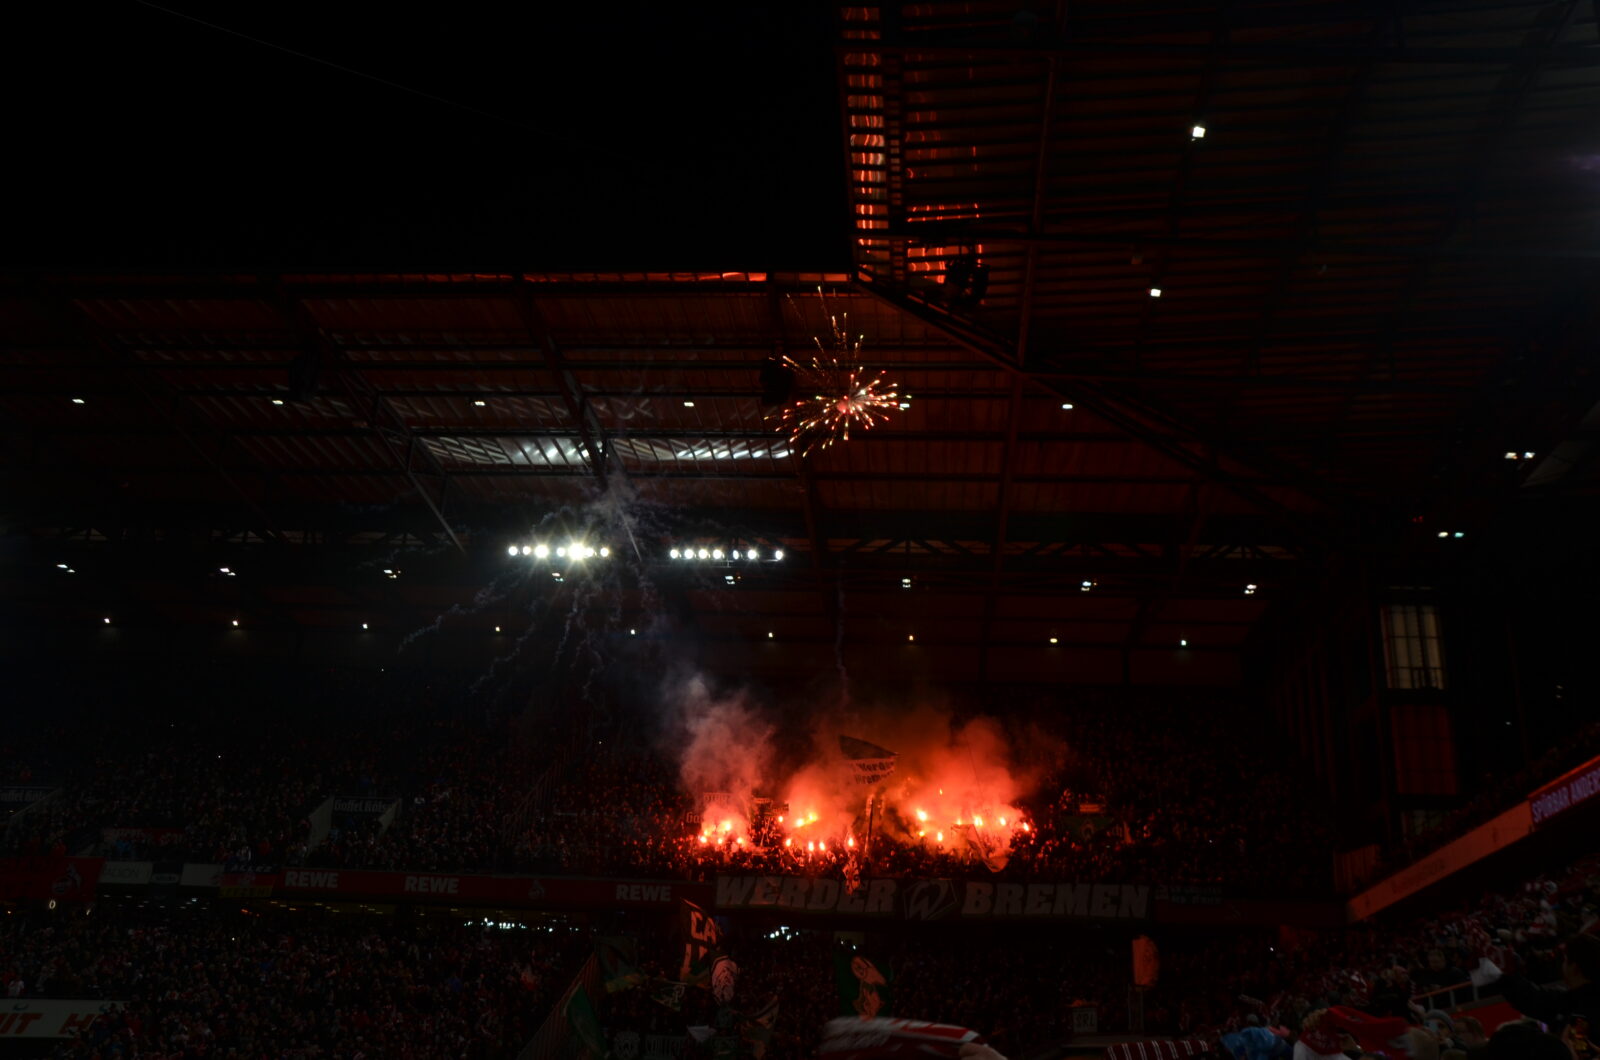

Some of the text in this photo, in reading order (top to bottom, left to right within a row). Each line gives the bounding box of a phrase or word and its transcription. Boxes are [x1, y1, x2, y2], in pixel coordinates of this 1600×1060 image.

[285, 871, 339, 888] REWE
[404, 876, 460, 893] REWE
[615, 884, 672, 902] REWE
[716, 876, 897, 913] WERDER
[961, 881, 1150, 918] BREMEN
